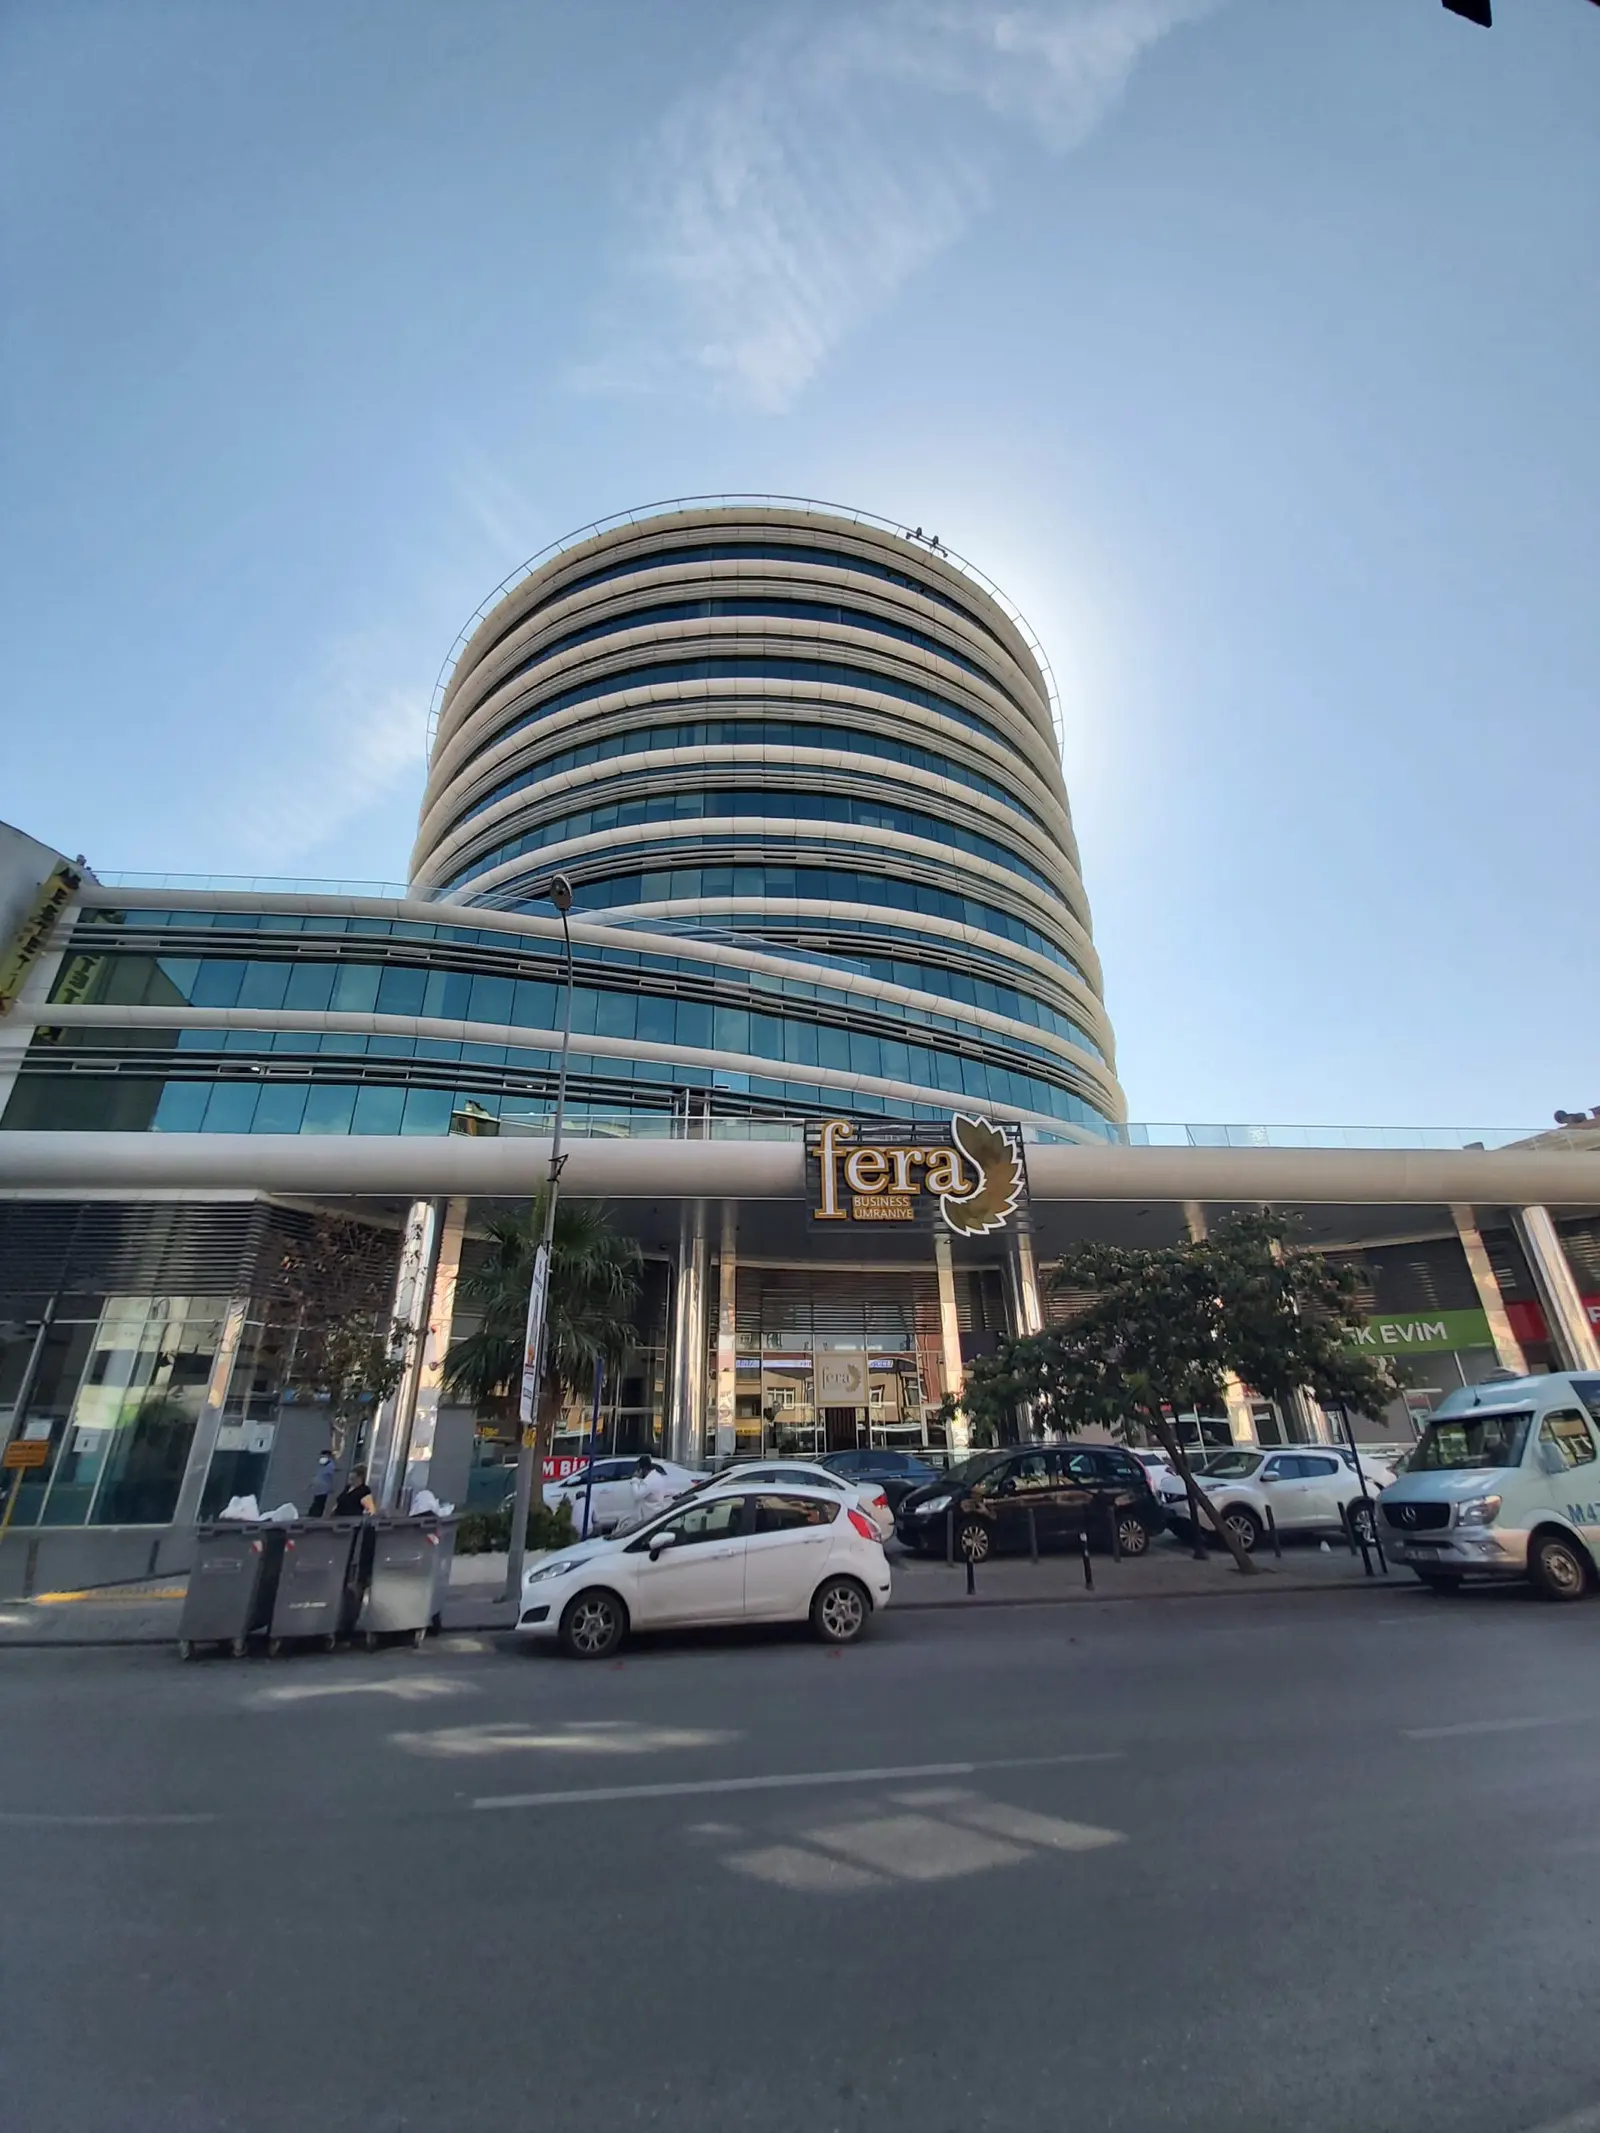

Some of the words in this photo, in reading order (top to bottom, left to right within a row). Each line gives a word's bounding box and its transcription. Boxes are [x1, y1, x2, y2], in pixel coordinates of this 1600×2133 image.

[813, 1119, 973, 1220] fera
[854, 1196, 910, 1207] BUSINESS
[1380, 1321, 1448, 1343] EVİM
[822, 1366, 850, 1390] fera
